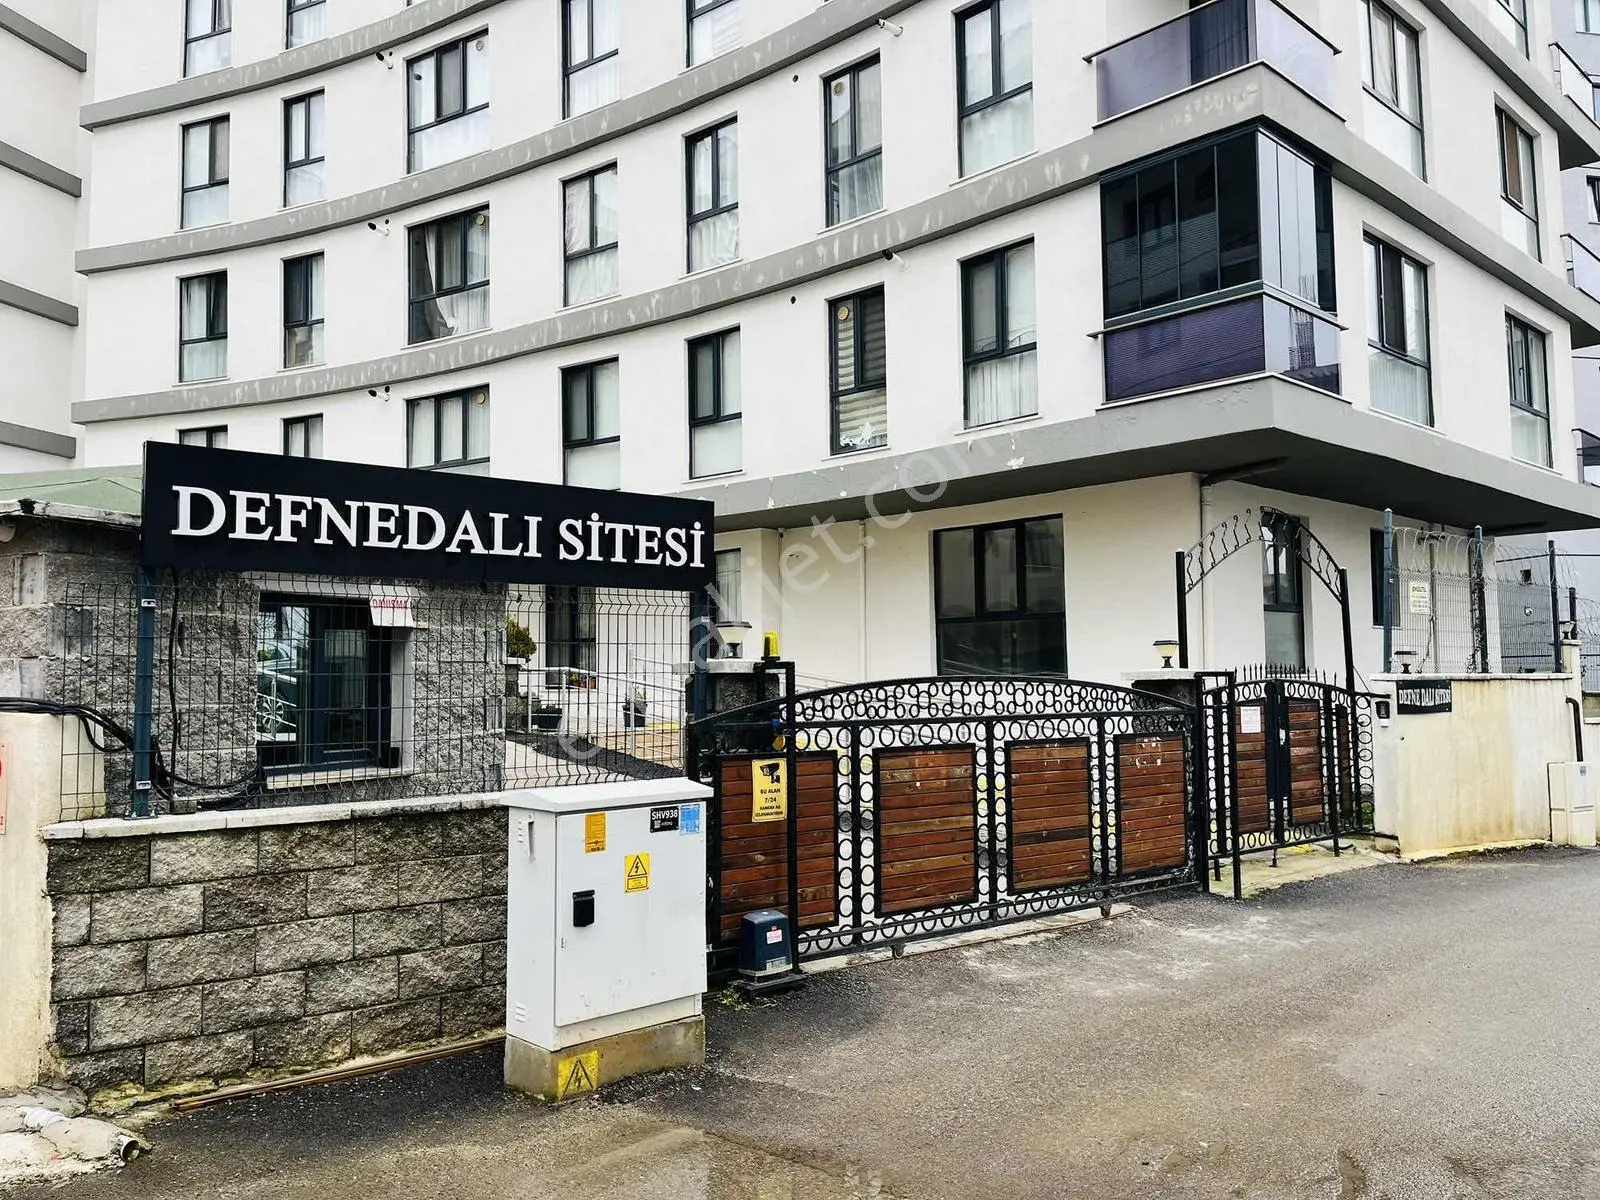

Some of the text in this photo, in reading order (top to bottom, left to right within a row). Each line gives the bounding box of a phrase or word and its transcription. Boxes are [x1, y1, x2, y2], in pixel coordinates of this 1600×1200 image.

[170, 485, 705, 568] DEFNEDALI SİTESİ
[651, 809, 678, 820] SHV938
